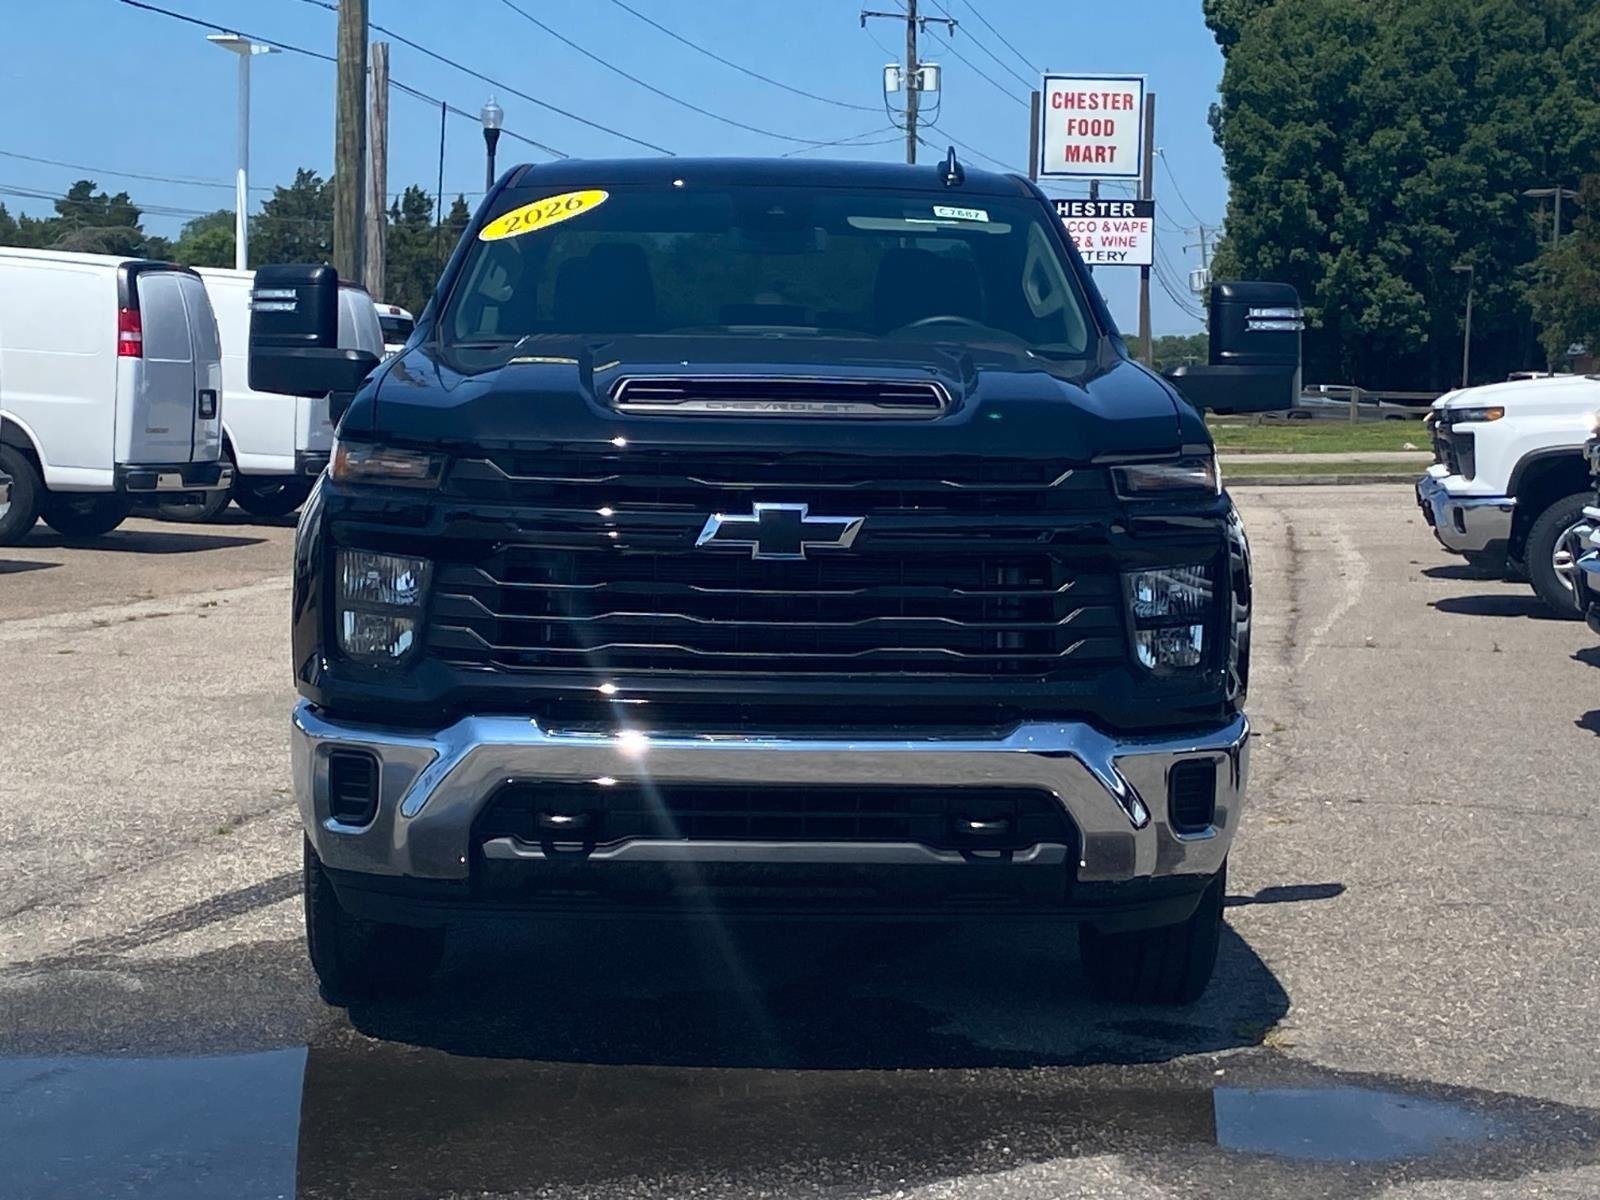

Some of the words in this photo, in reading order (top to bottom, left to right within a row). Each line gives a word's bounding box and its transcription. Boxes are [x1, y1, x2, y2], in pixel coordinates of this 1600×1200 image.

[1051, 92, 1134, 110] CHESTER
[1067, 118, 1115, 137] FOOD
[1064, 145, 1117, 163] MART
[504, 197, 583, 233] 2026
[1056, 202, 1135, 216] HESTER
[1067, 221, 1097, 233] CCO
[1102, 221, 1111, 233] &
[1113, 221, 1148, 233] VAPE
[1073, 235, 1081, 247] R
[1084, 235, 1094, 248] &
[1100, 236, 1137, 248] WINE
[705, 402, 854, 412] CHEVROLET
